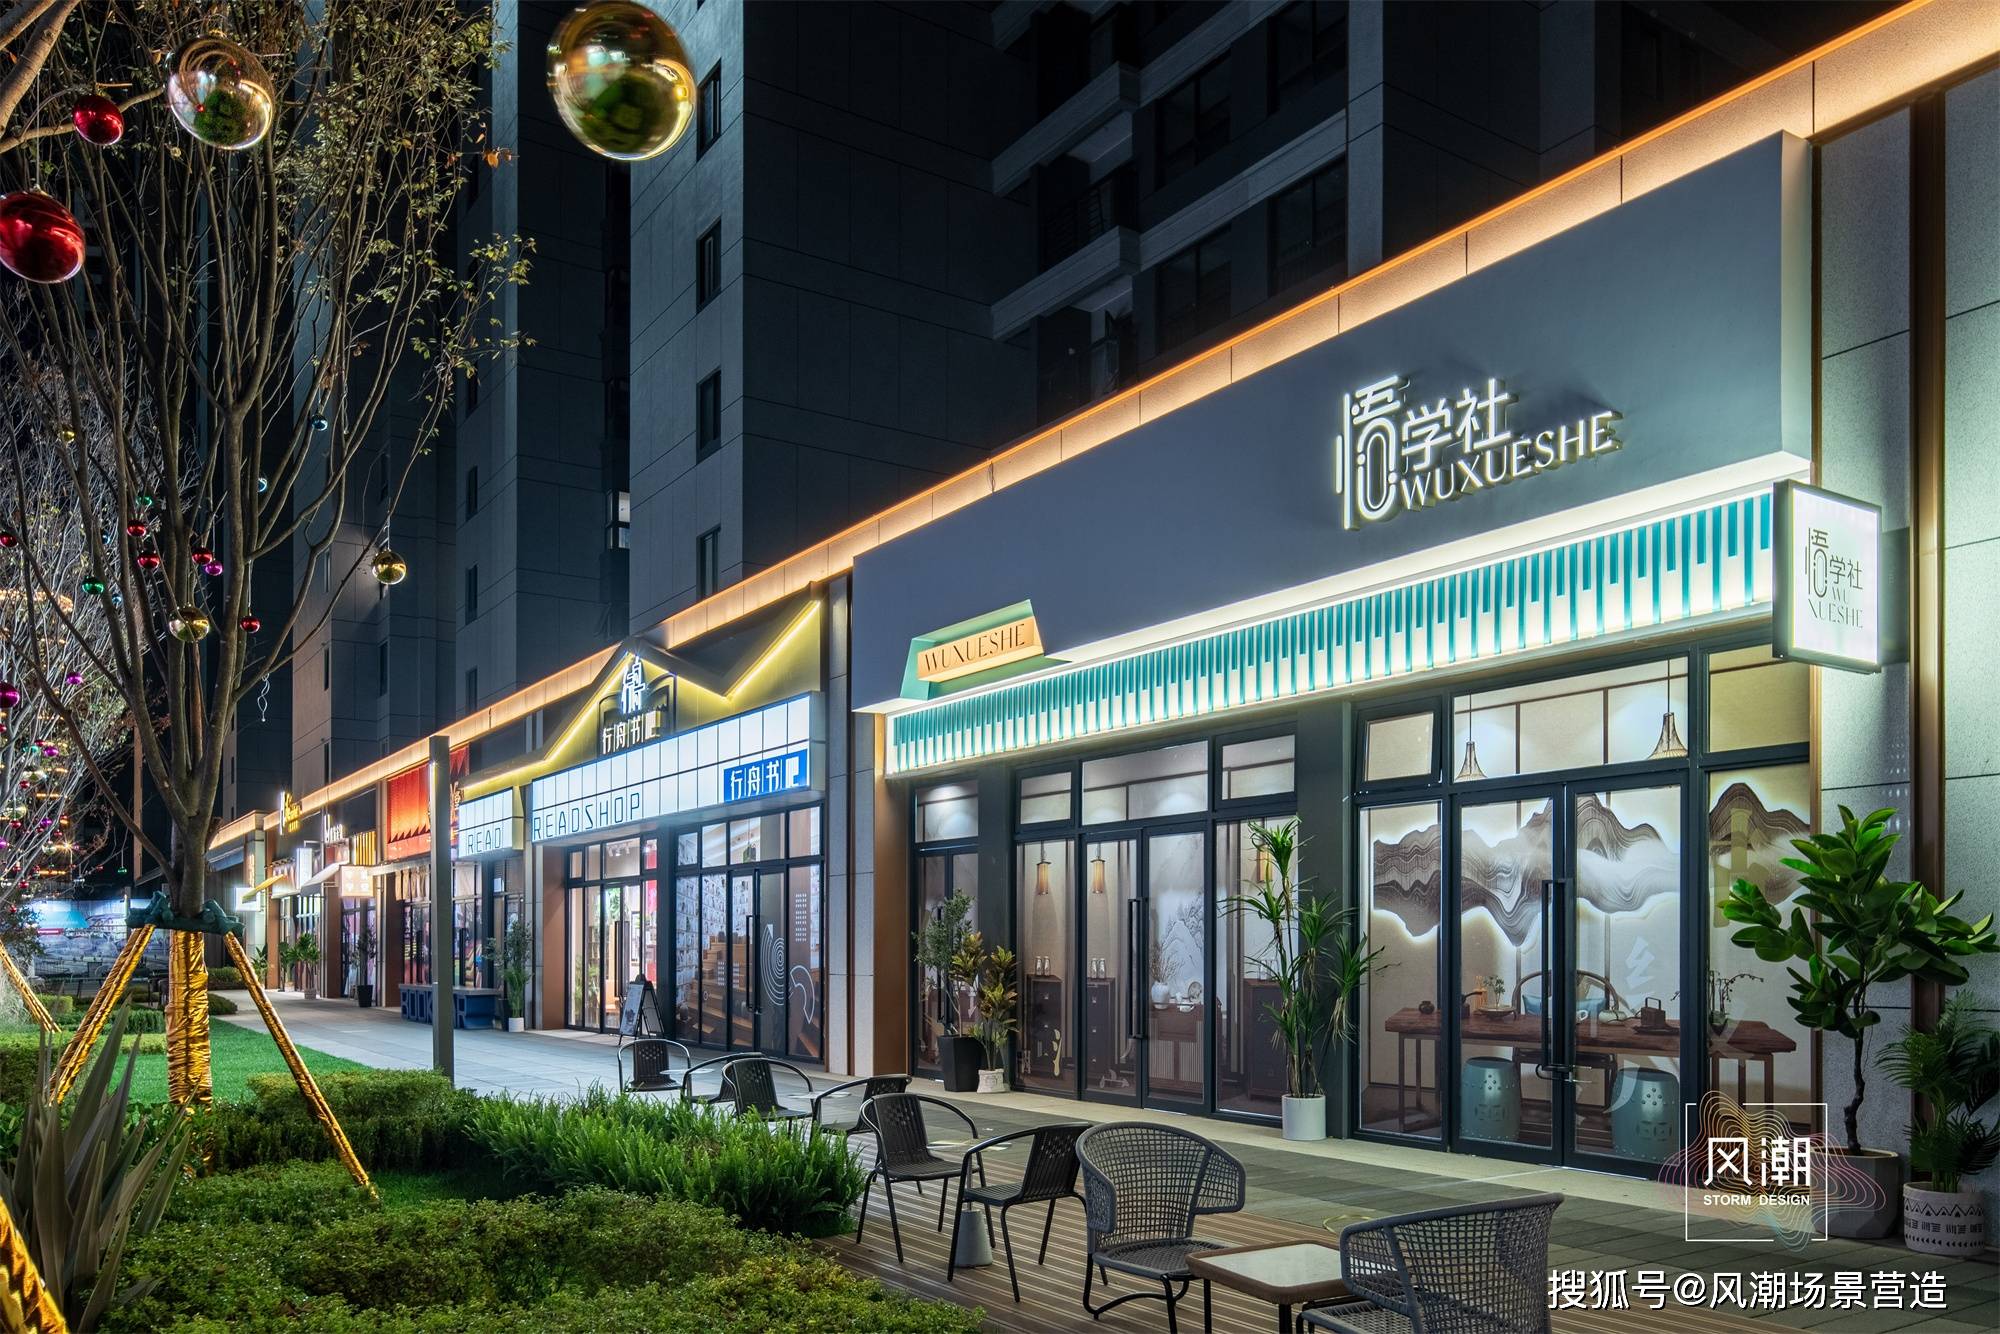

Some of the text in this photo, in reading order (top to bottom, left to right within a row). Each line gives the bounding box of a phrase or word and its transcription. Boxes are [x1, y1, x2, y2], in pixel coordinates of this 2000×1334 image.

[1335, 374, 1516, 531] 悟学社
[1401, 410, 1622, 512] WUXUESHE
[1804, 526, 1864, 599] 悟学社
[1831, 585, 1849, 605] WU
[924, 623, 1026, 673] WUXUESHE
[602, 710, 661, 755] 行舟书吧
[730, 755, 800, 801] 行舟书吧
[467, 826, 502, 855] READ
[533, 792, 641, 841] READSHOP
